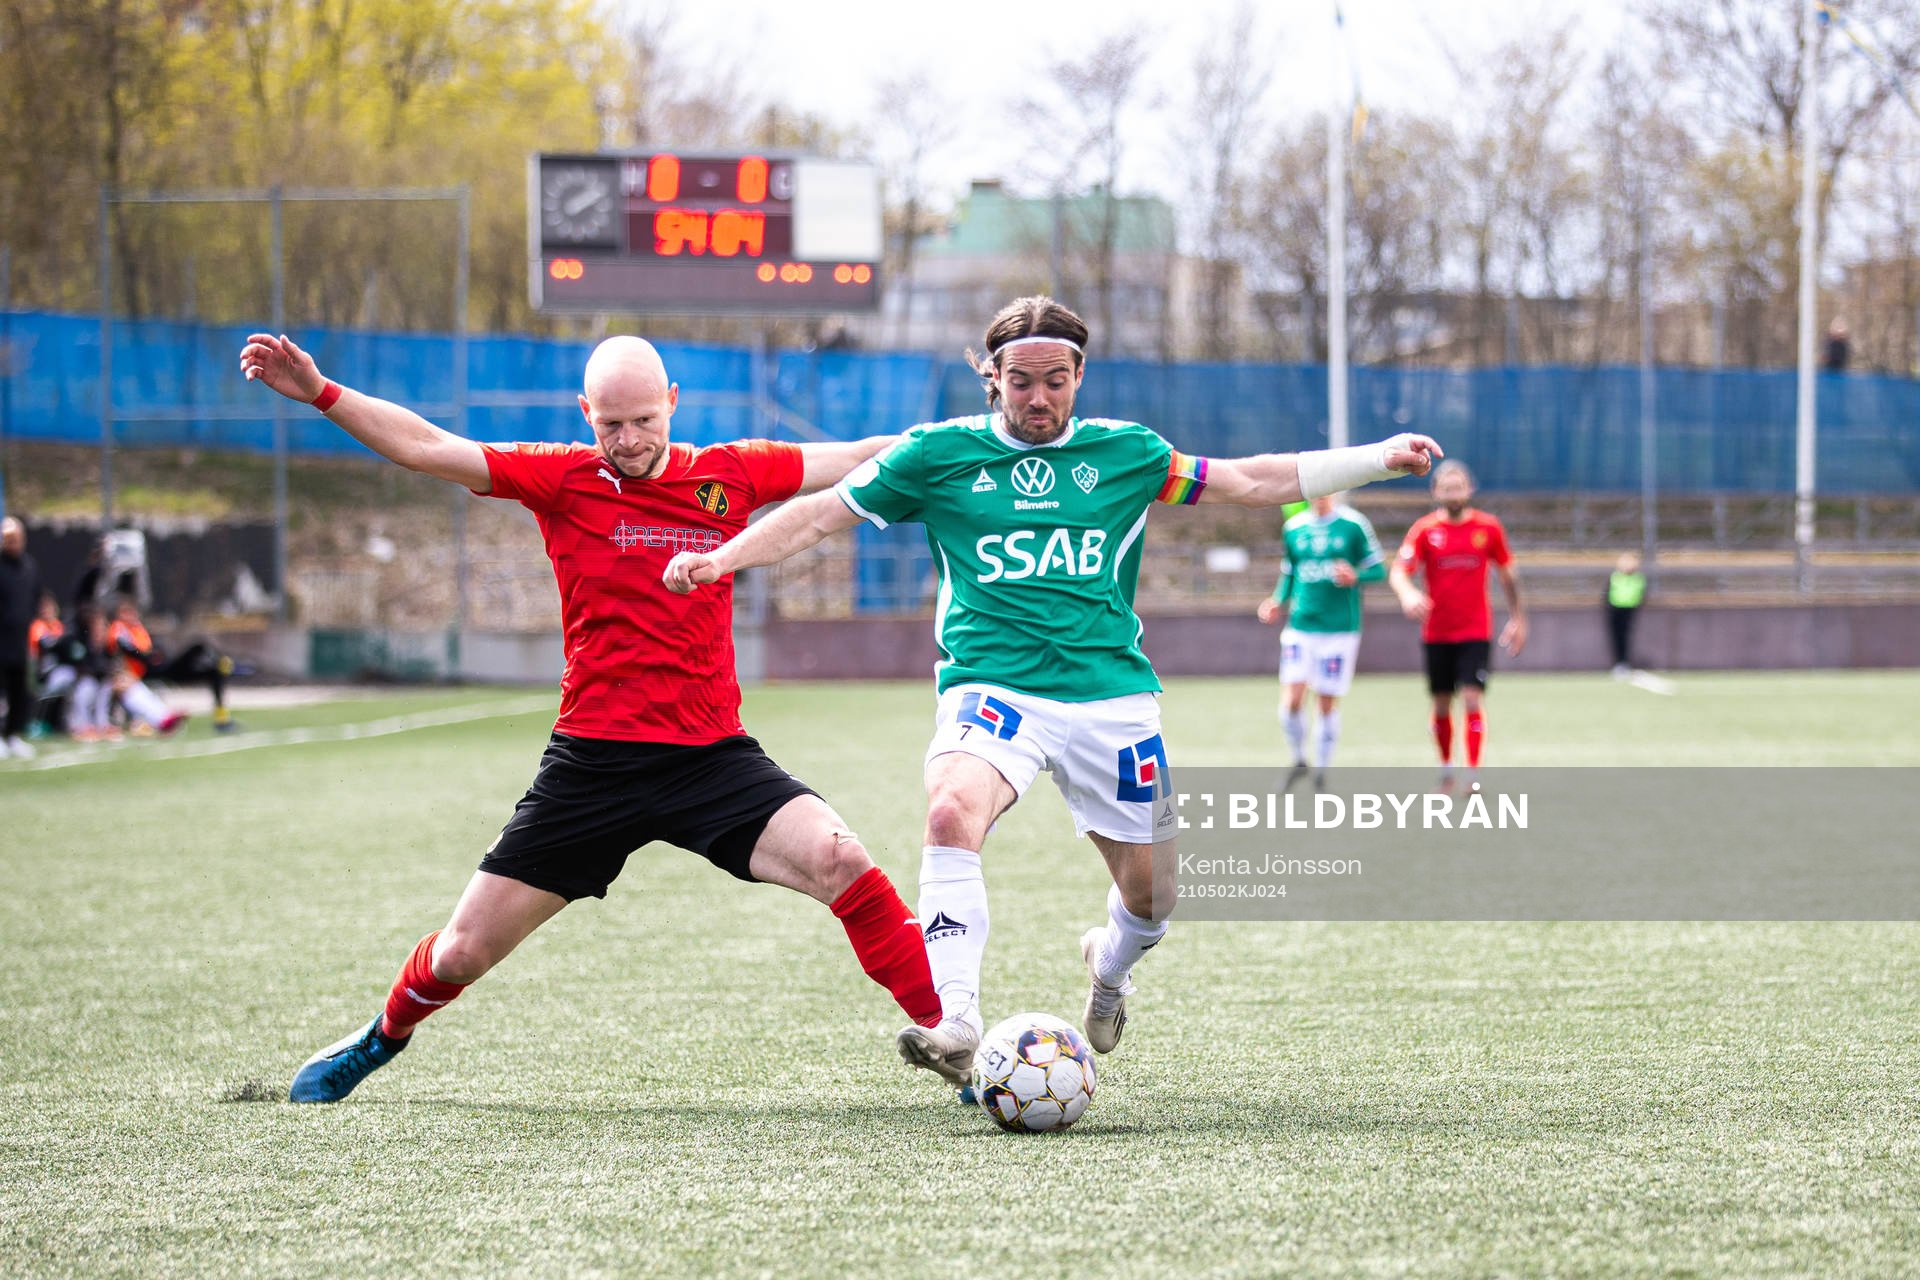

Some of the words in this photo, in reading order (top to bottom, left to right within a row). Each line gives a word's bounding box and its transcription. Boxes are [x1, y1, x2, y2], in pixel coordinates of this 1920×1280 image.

[972, 483, 997, 492] SELECT
[1014, 500, 1060, 510] Bilmetro
[976, 528, 1107, 583] SSAB
[959, 725, 972, 741] 7
